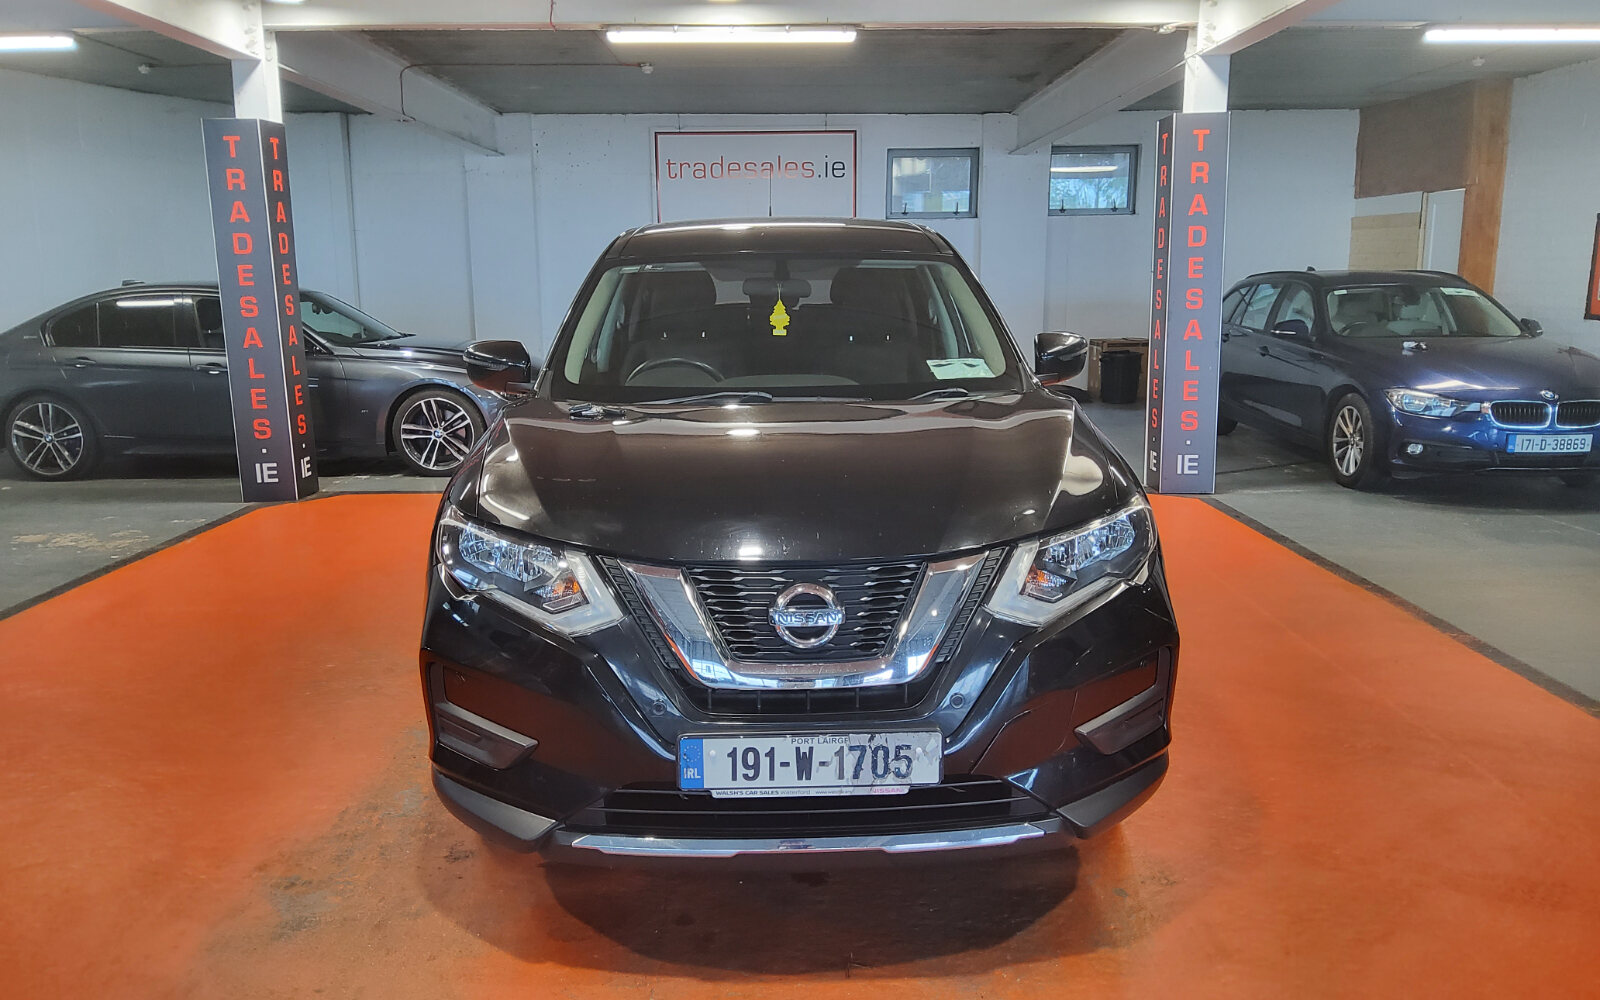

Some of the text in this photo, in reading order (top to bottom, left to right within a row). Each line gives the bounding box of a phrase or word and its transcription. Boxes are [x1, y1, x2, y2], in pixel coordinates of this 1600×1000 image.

[665, 154, 847, 180] tradesales.ie
[1520, 438, 1587, 451] 171-D-38869
[777, 611, 838, 624] NISSAN
[791, 737, 815, 745] PORT
[727, 745, 913, 782] 191-W-1705
[683, 767, 702, 779] IRL
